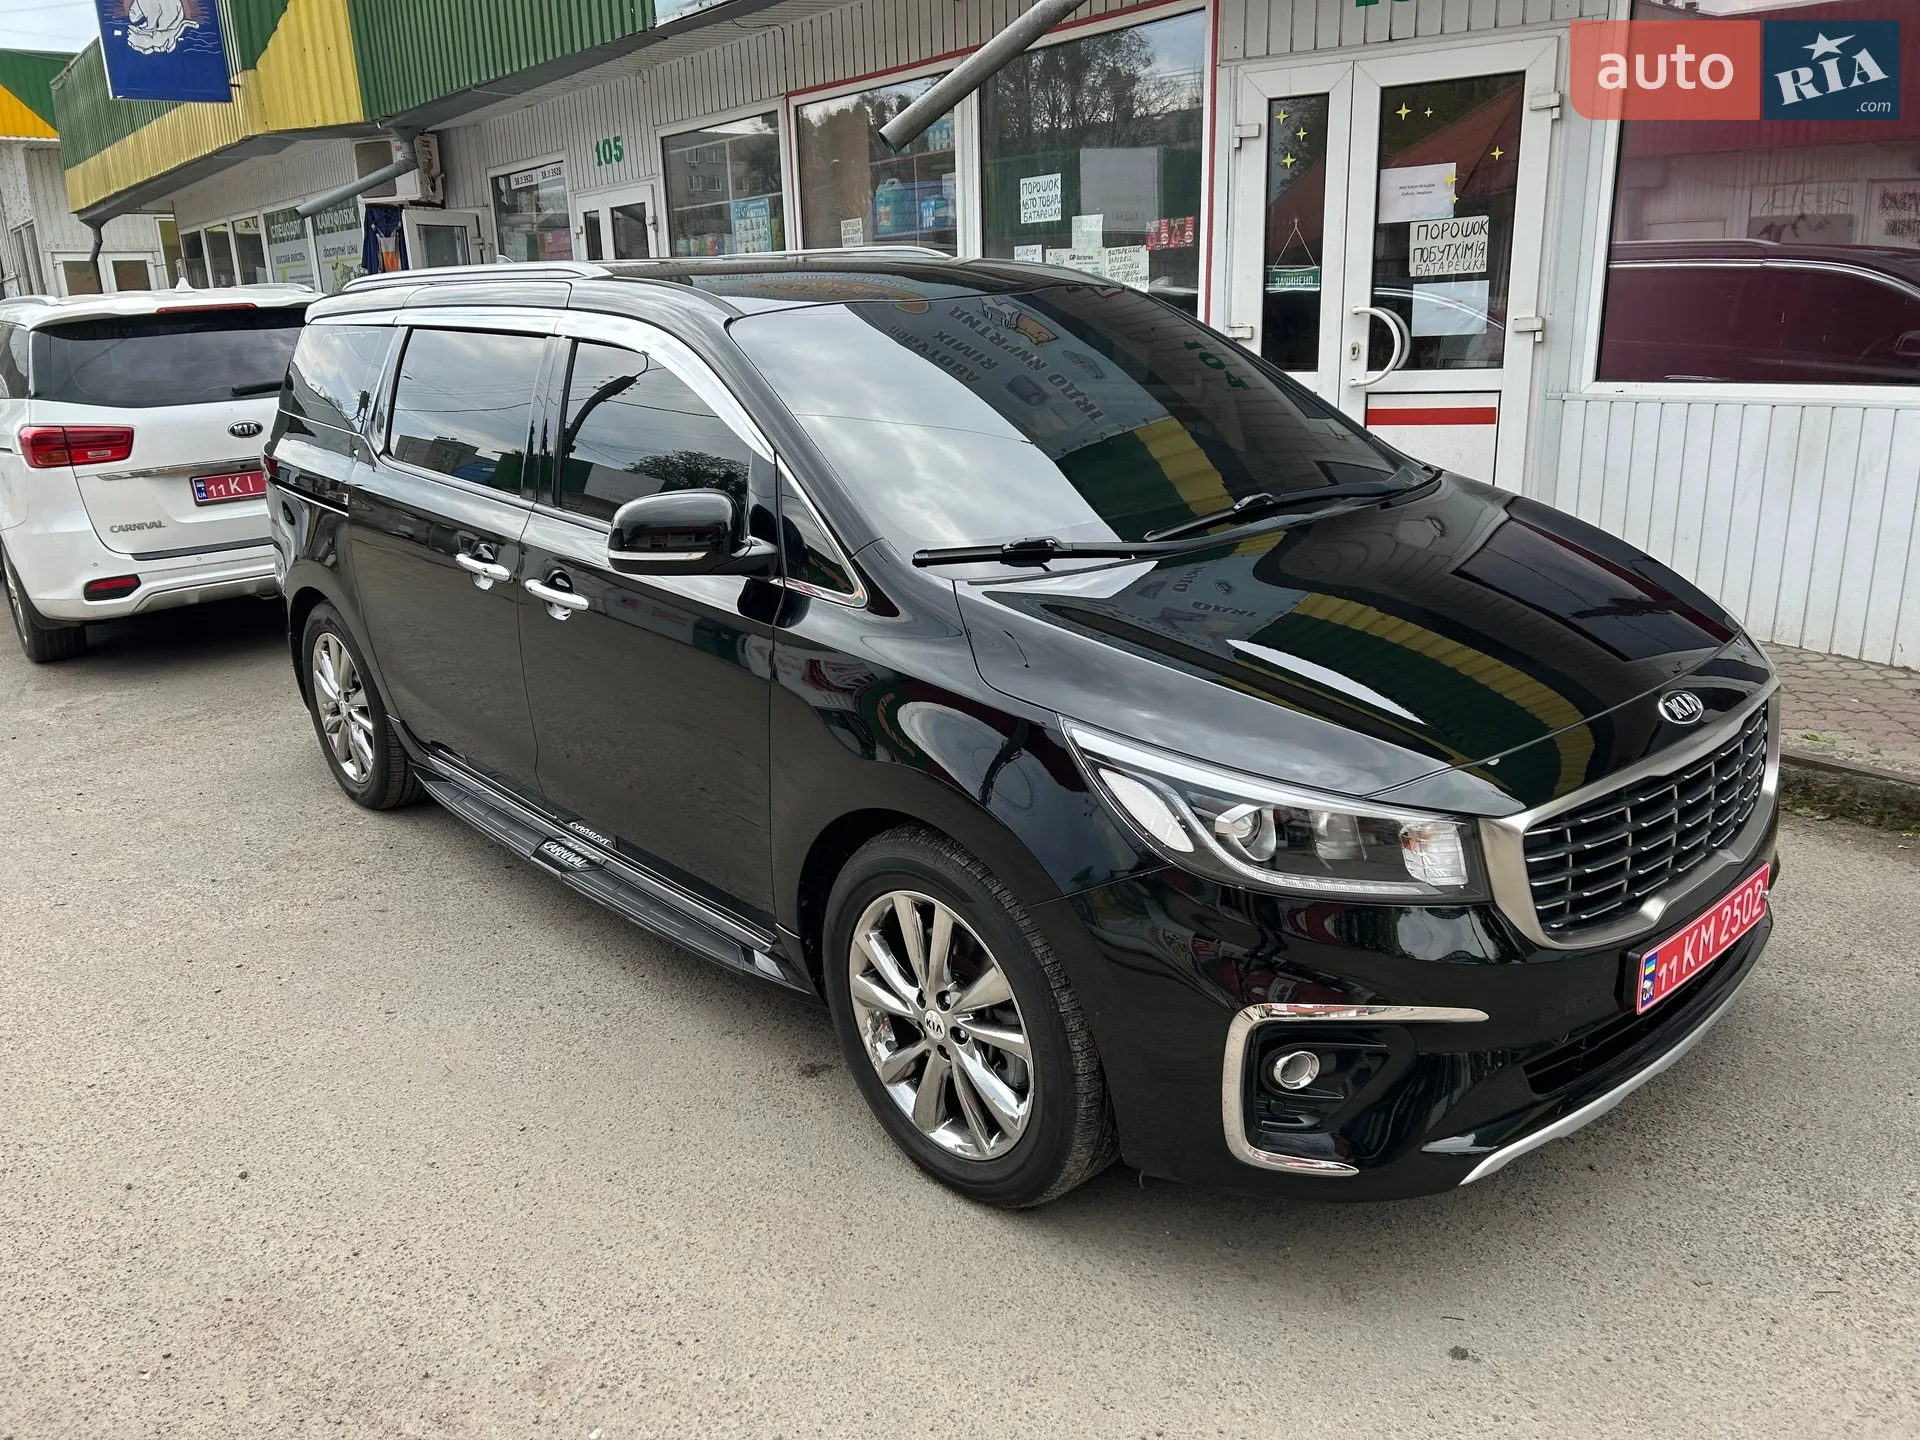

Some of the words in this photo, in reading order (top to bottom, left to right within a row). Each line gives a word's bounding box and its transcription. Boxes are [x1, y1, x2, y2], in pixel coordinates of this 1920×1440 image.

[594, 136, 624, 167] 105
[1022, 178, 1060, 196] ПОРОШОК
[315, 206, 356, 230] КАМУФЛЯЖ
[1417, 219, 1489, 241] ПОРОШОК
[1415, 259, 1486, 277] БАТАРЕЙКА
[1275, 275, 1314, 287] ЗАЧИНЕНО
[233, 424, 258, 435] KIA
[208, 484, 226, 497] 11
[108, 520, 166, 534] CARNIVAL
[1664, 693, 1701, 719] KIA
[543, 841, 587, 868] CARNIVAL
[1658, 955, 1678, 991] 11
[1682, 916, 1716, 975] KM
[1719, 878, 1764, 946] 2502
[926, 1018, 943, 1034] KIA
